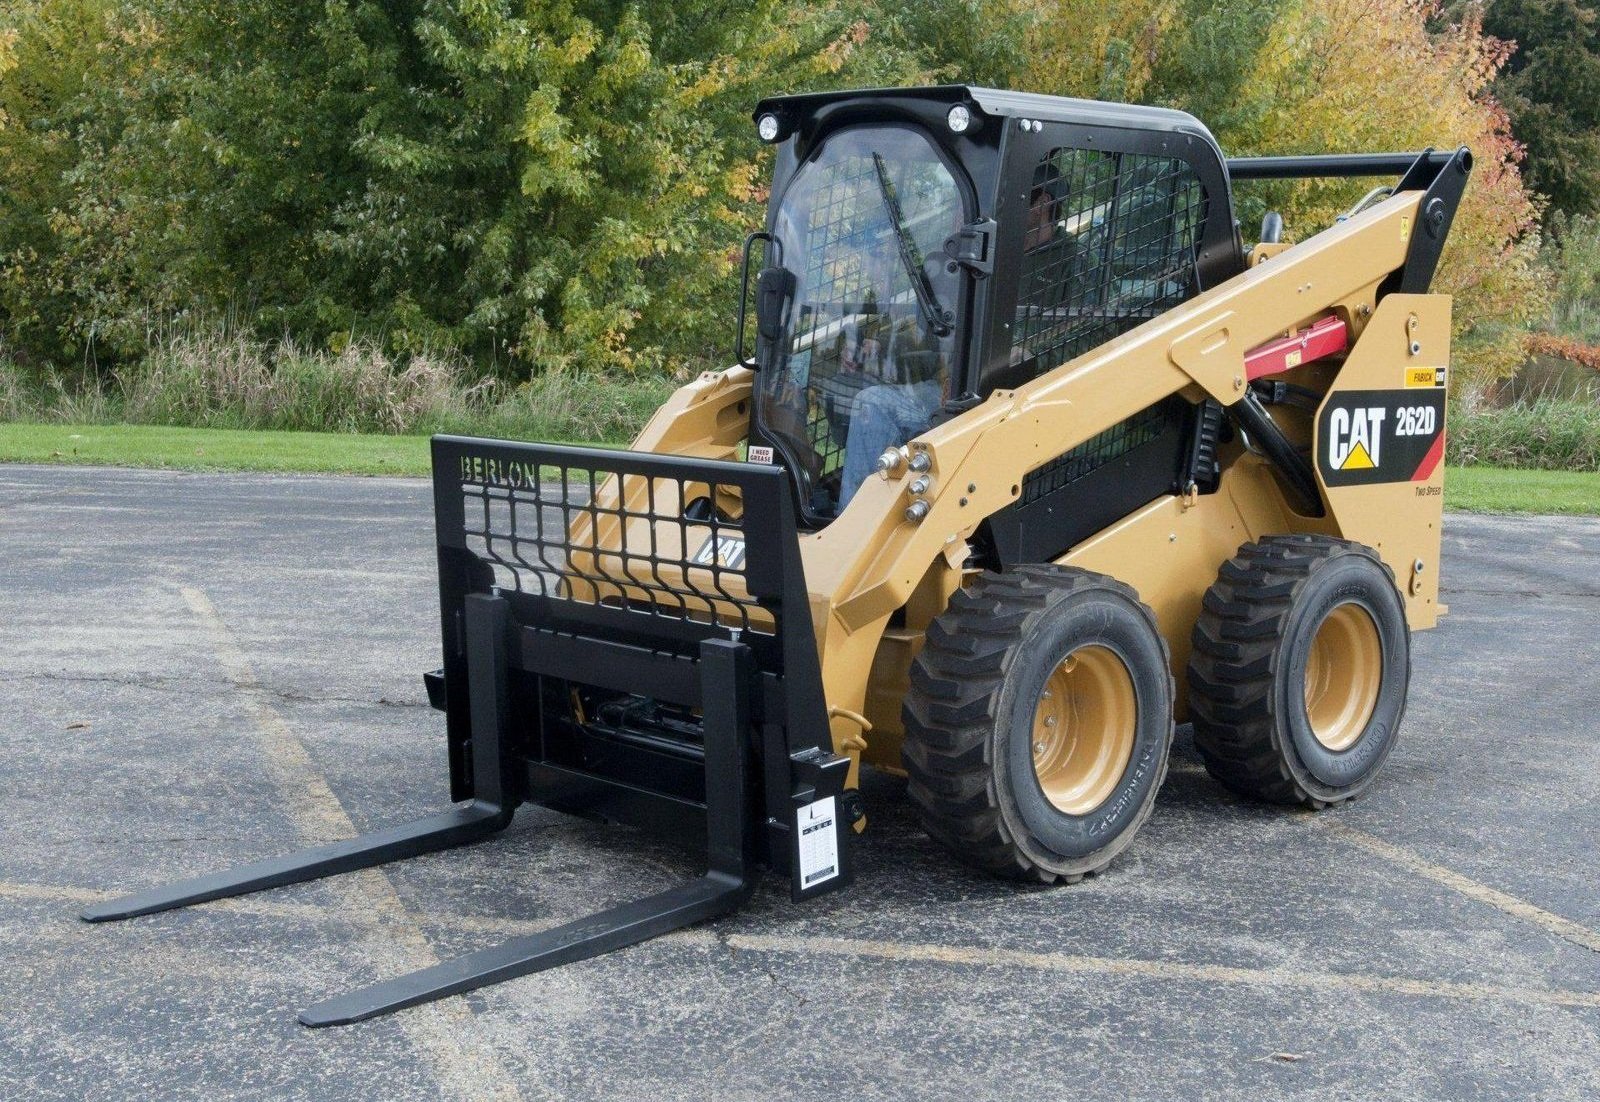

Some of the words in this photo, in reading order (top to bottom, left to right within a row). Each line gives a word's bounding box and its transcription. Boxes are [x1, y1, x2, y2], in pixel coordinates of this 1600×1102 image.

[1329, 407, 1386, 470] CAT
[1395, 406, 1436, 436] 262D
[460, 455, 536, 489] BERLON
[750, 455, 771, 463] GREASE
[697, 537, 746, 567] CAT
